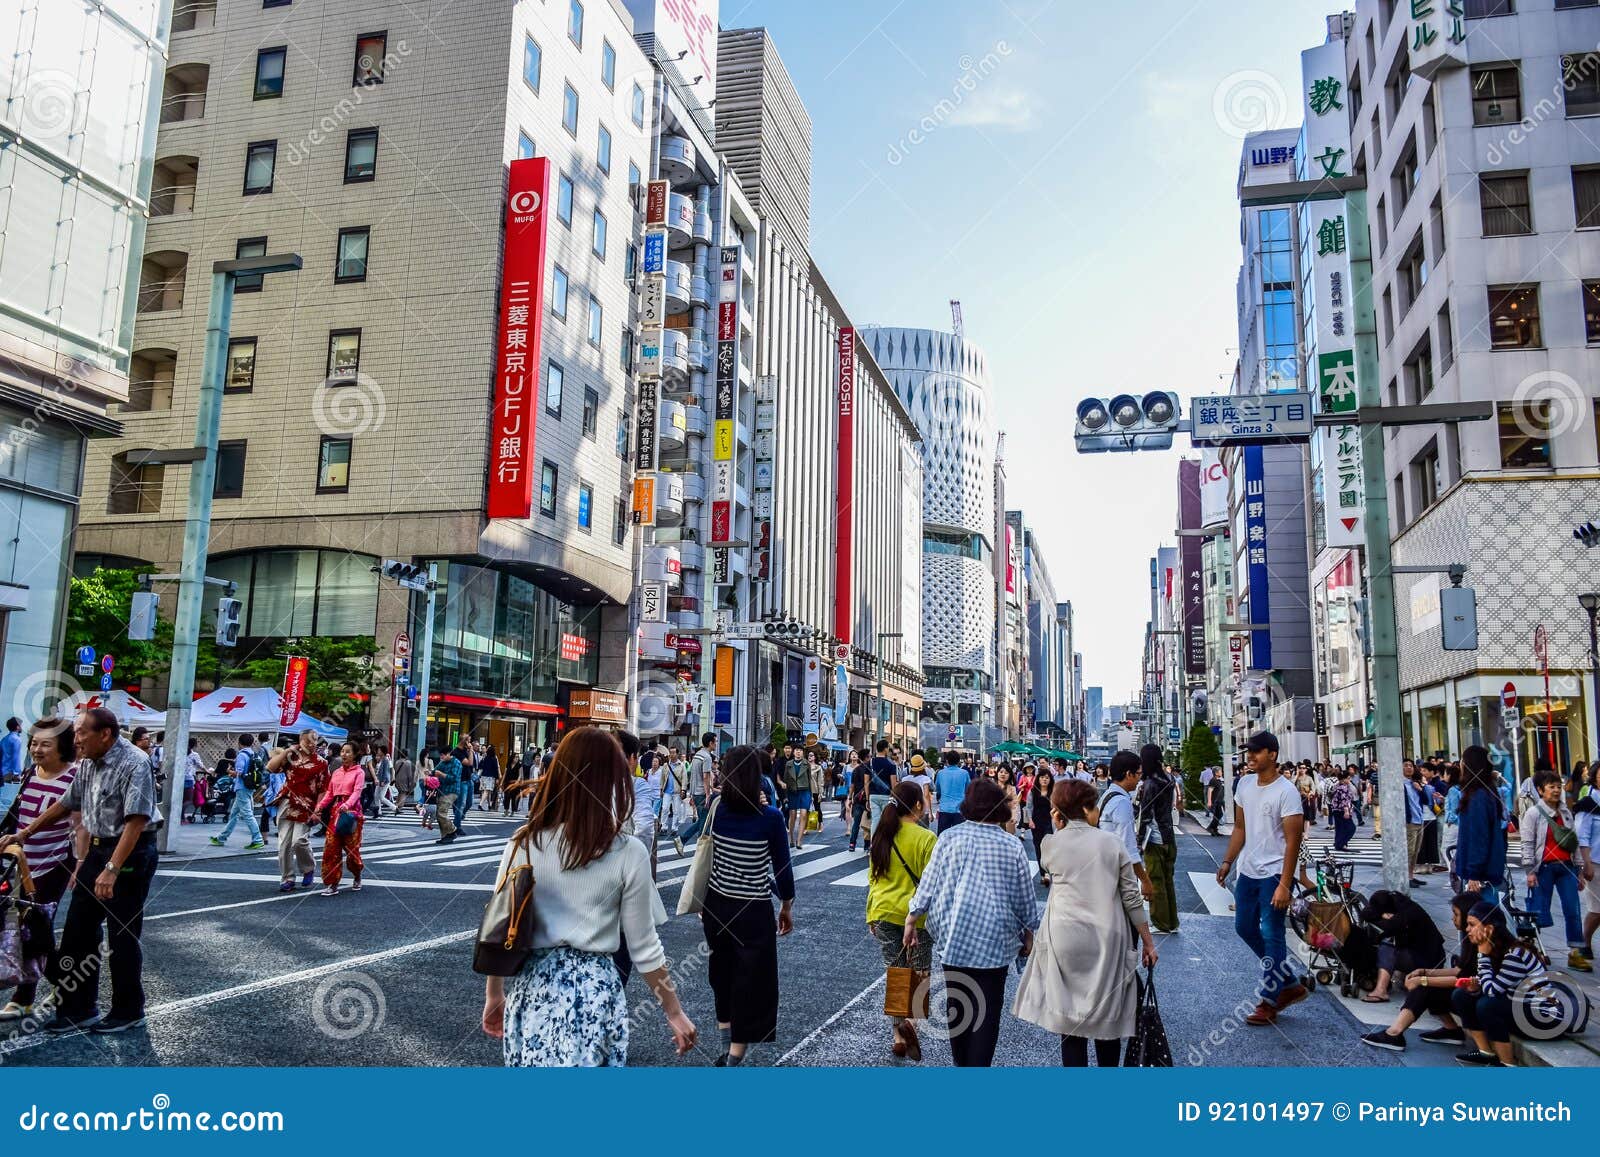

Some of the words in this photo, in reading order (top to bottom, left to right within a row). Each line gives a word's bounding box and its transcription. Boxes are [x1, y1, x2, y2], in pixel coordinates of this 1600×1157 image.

[1309, 76, 1346, 257] 教文館
[514, 214, 535, 224] MUFG
[646, 282, 656, 319] ざくろ
[1330, 271, 1342, 307] SINCE
[498, 280, 531, 484] 三菱東京UFJ銀行
[840, 333, 852, 416] MITSUKOSHI
[1323, 360, 1355, 402] 本
[1199, 398, 1232, 406] 中央区
[1199, 404, 1304, 425] 銀座三丁目
[1231, 424, 1261, 435] Ginza
[1266, 423, 1273, 433] 3
[1336, 425, 1357, 508] ナルニア国
[1248, 479, 1265, 564] 山野楽器
